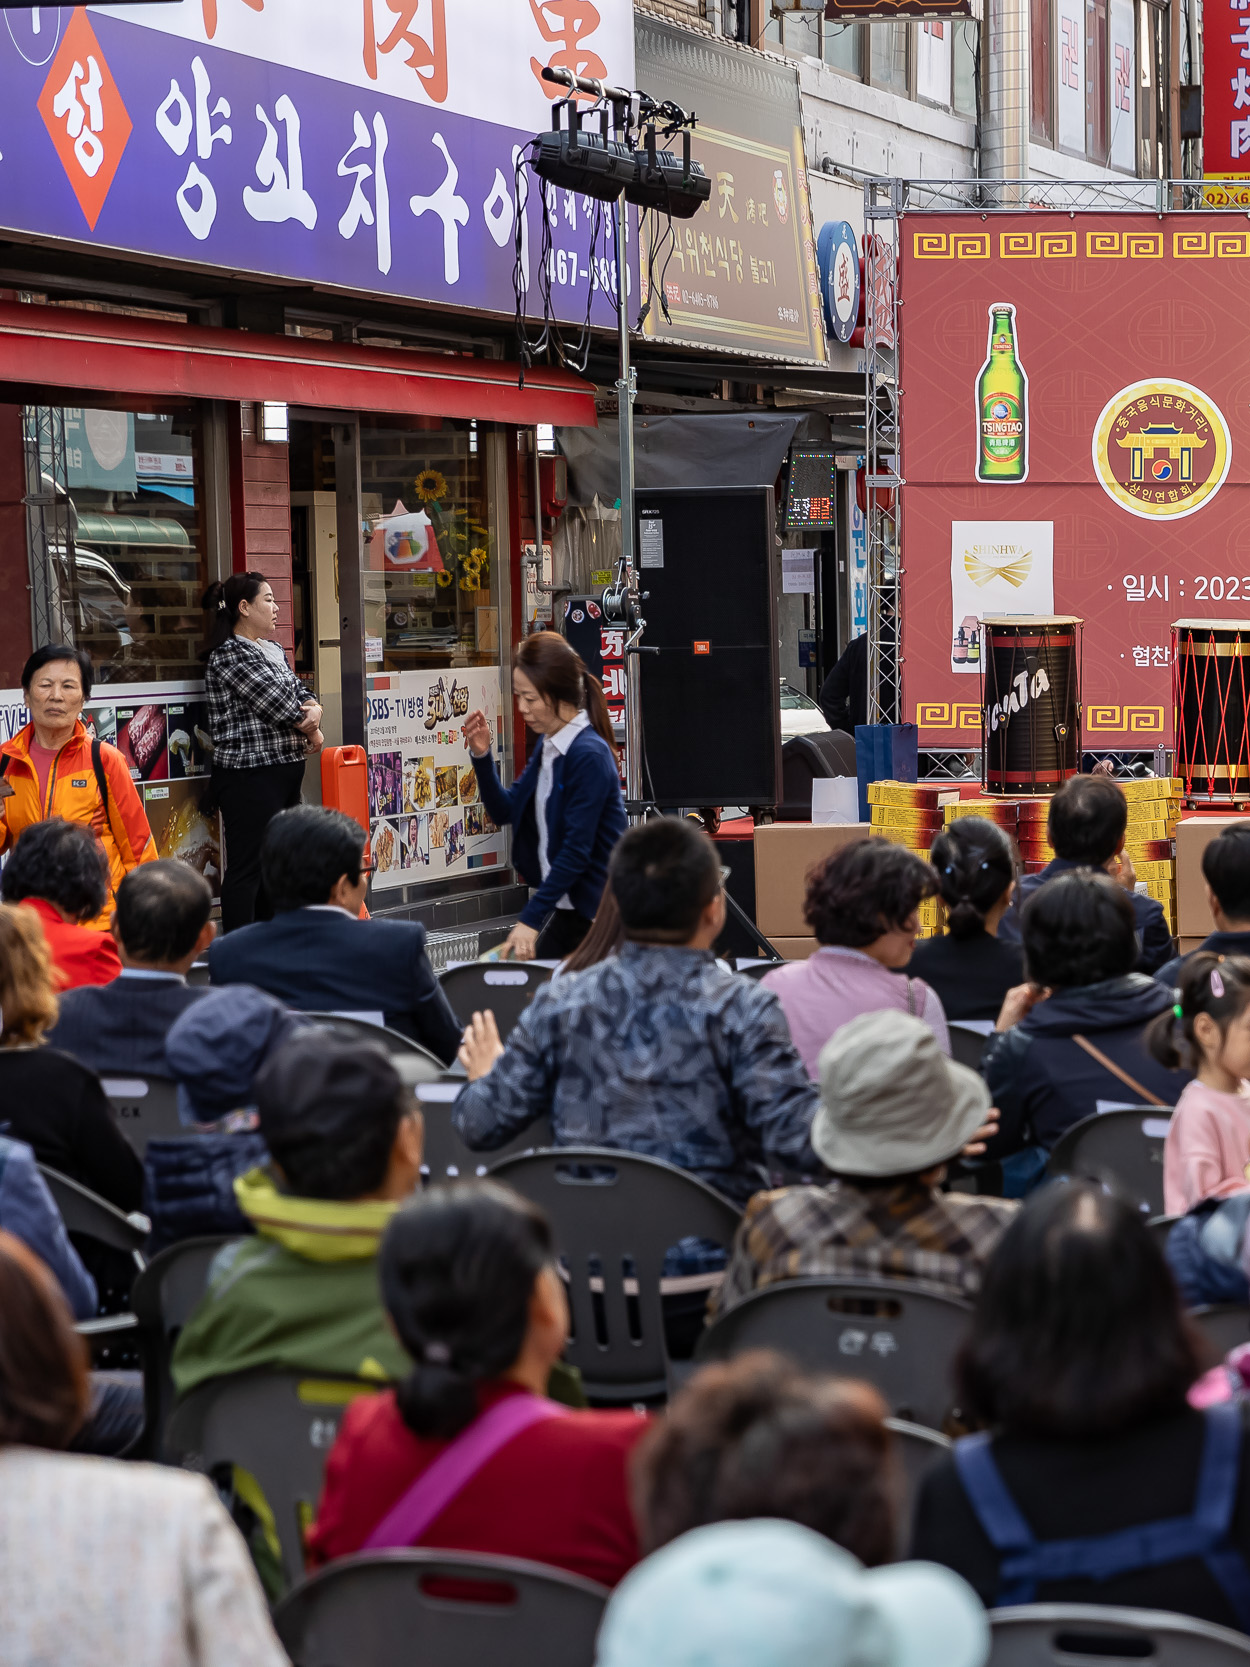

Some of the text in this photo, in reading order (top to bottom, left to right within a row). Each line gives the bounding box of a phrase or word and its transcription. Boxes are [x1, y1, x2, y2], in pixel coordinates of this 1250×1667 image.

[202, 0, 608, 103] 肉串
[155, 55, 530, 293] 양꼬치구이
[1116, 395, 1208, 430] 중국음식문화거리
[982, 422, 1023, 433] TSINGTAO
[1129, 483, 1192, 503] 상인연합회
[973, 545, 1025, 555] SHINHWA
[1122, 575, 1169, 602] 일시
[372, 696, 424, 721] SBS-TV방영
[987, 669, 1050, 738] anTa
